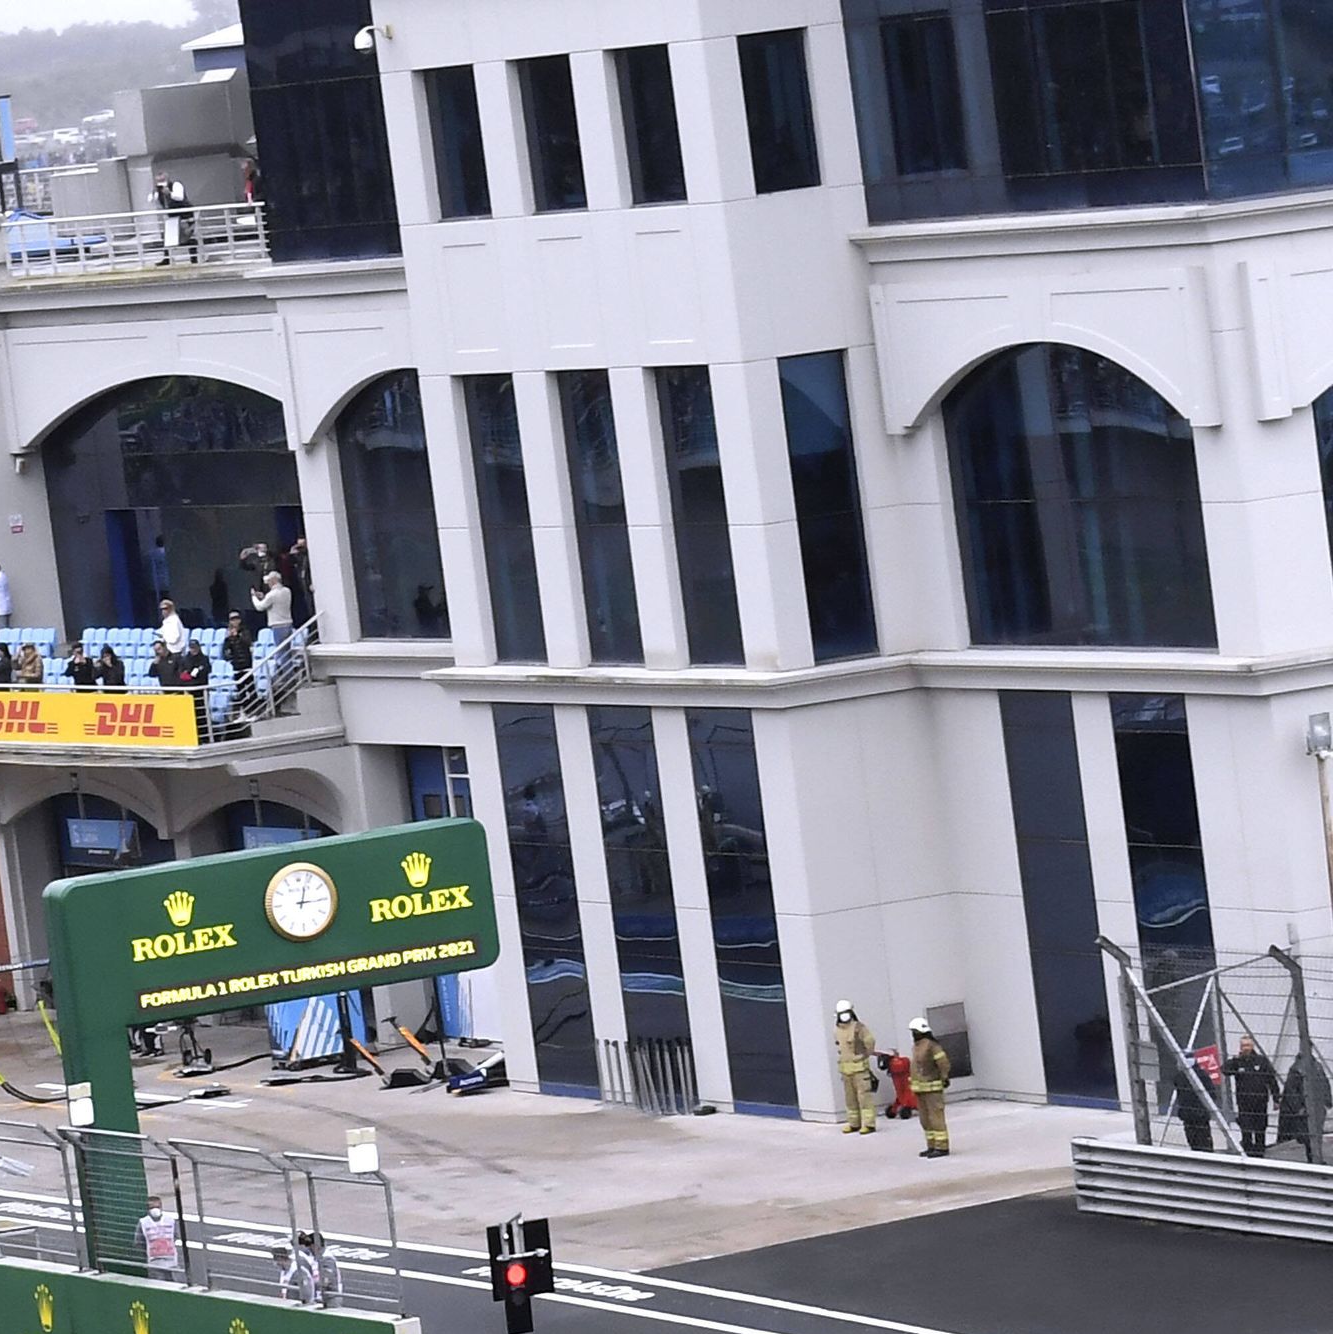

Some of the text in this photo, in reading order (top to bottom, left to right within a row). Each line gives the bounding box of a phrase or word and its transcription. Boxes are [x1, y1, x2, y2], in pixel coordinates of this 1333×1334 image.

[95, 702, 162, 737] DHL
[369, 886, 473, 923] ROLEX
[132, 924, 237, 962] ROLEX
[140, 940, 475, 1008] FORMULA 1 ROLEX TURKISH GRAND PRIX 2021
